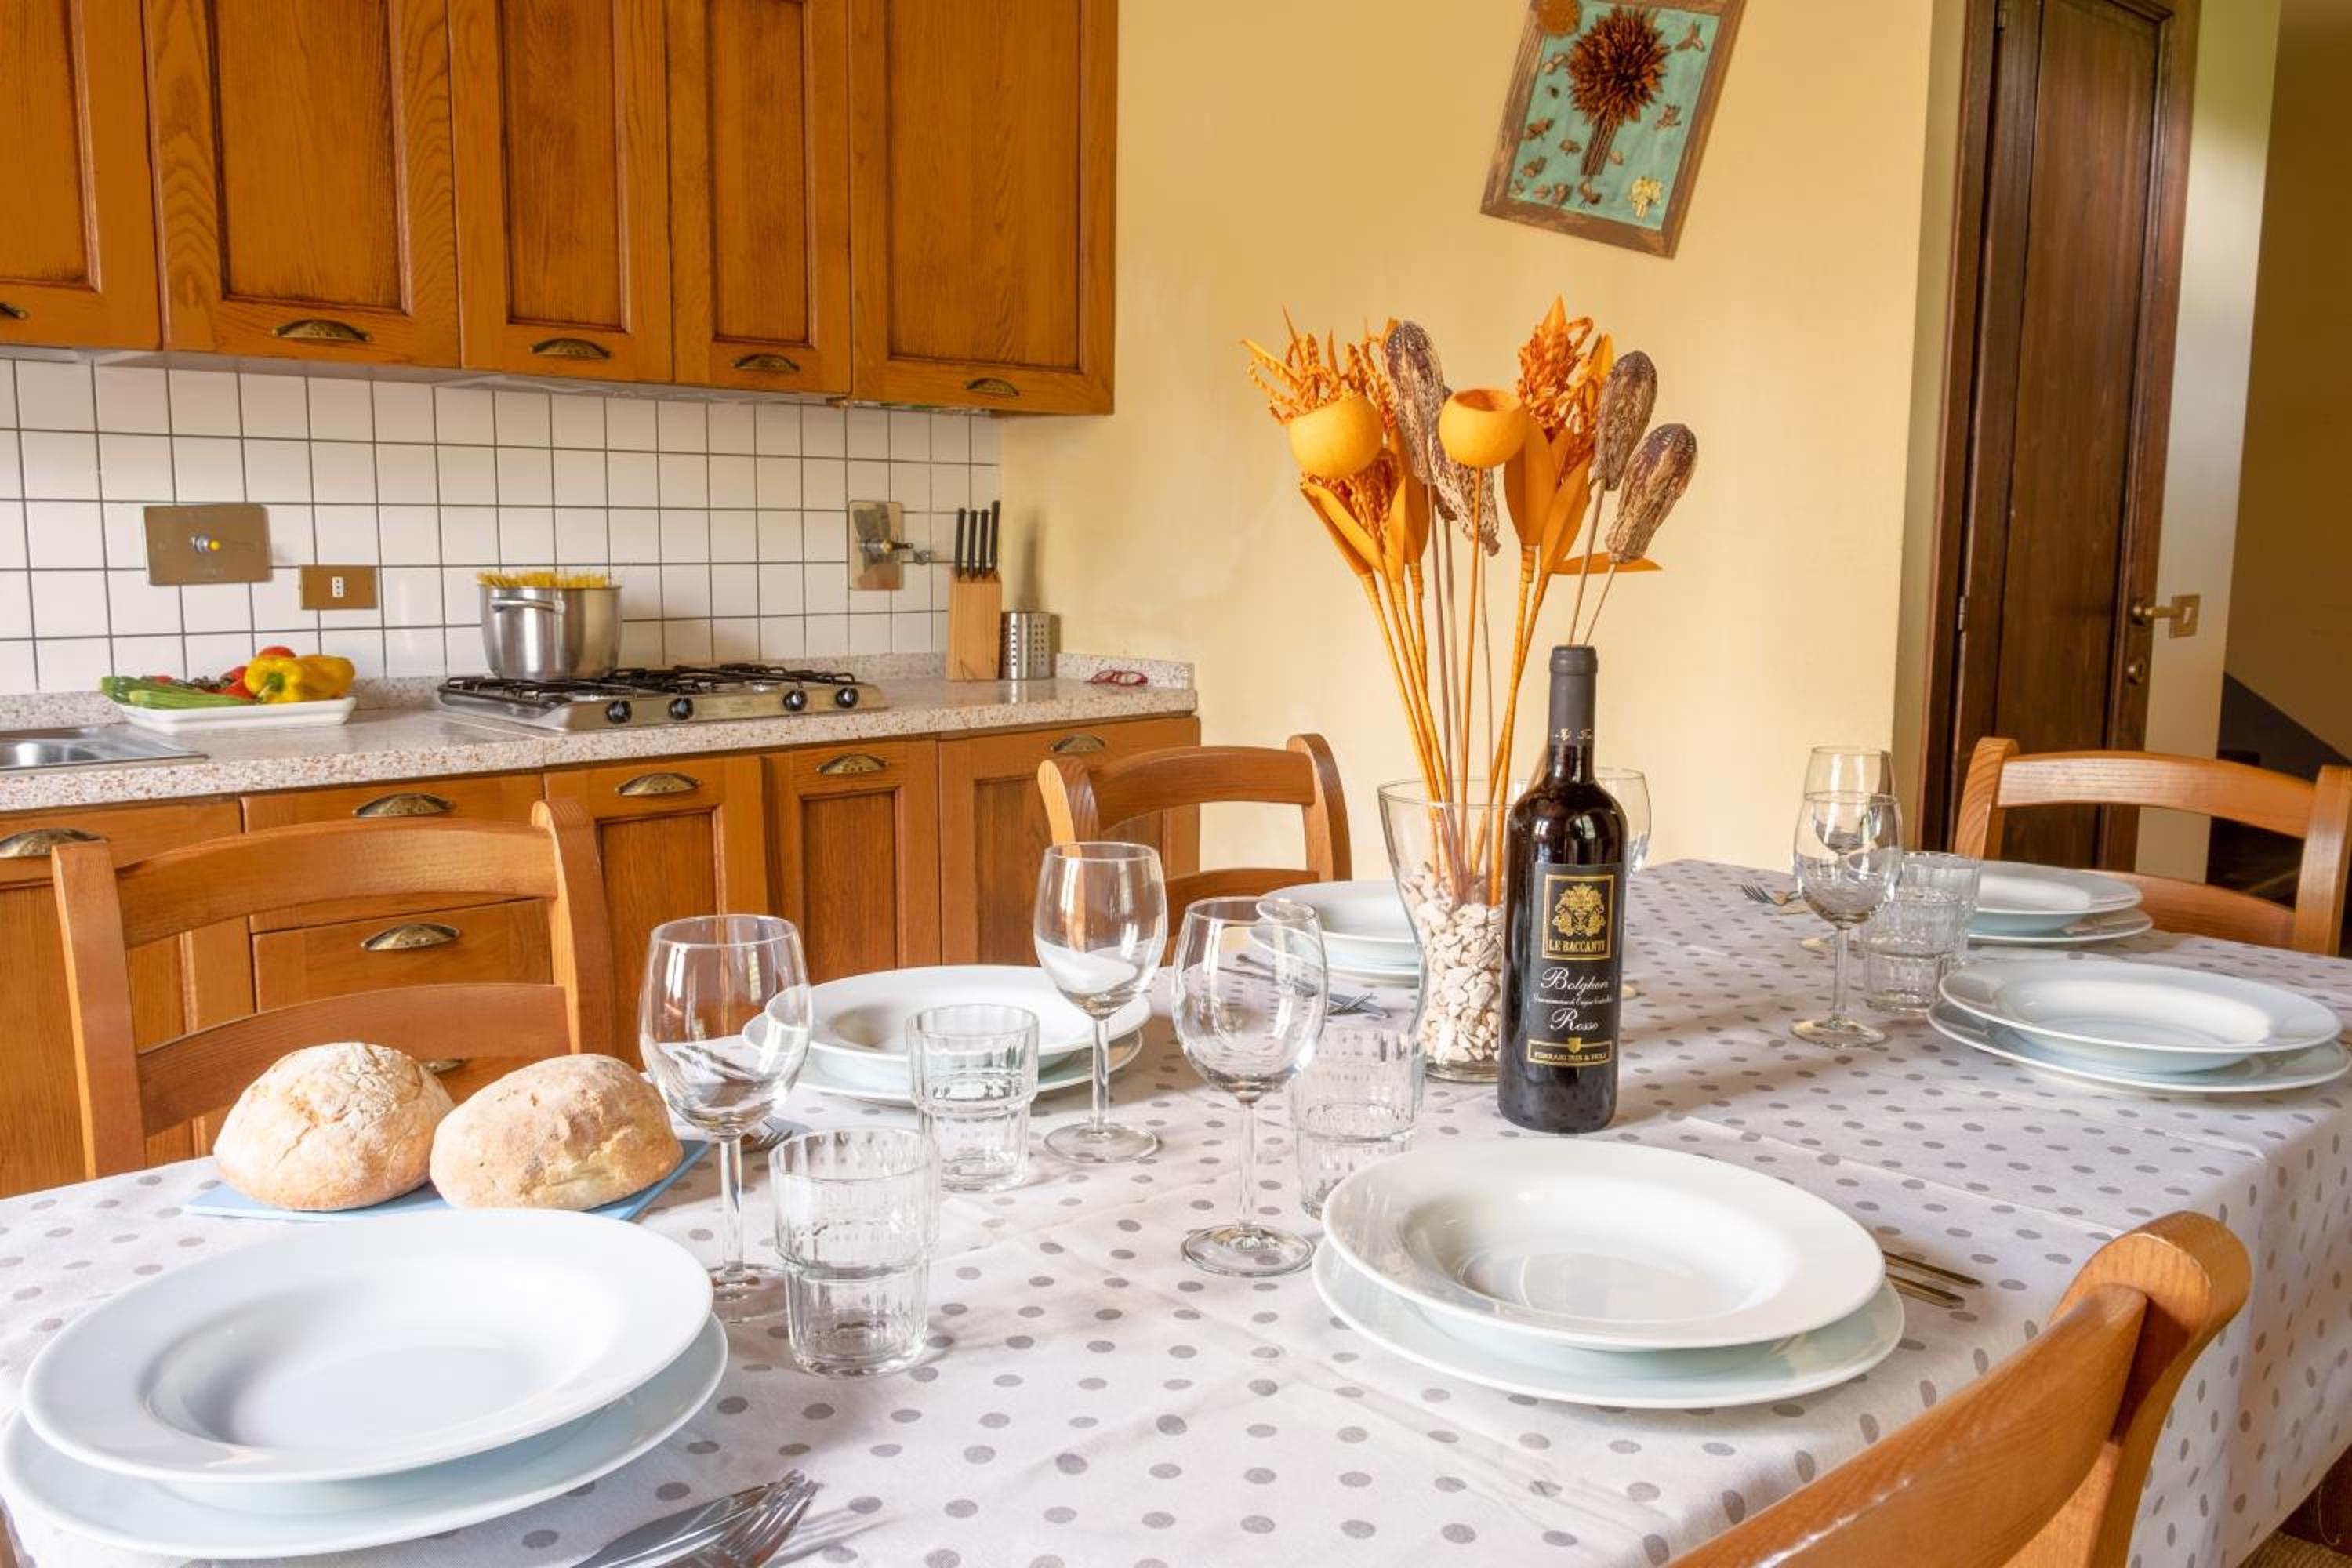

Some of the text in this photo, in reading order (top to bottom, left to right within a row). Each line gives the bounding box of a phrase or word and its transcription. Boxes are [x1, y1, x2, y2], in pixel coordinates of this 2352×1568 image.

[1548, 939, 1605, 953] LE BACCANTI
[1549, 1007, 1599, 1031] Rosso
